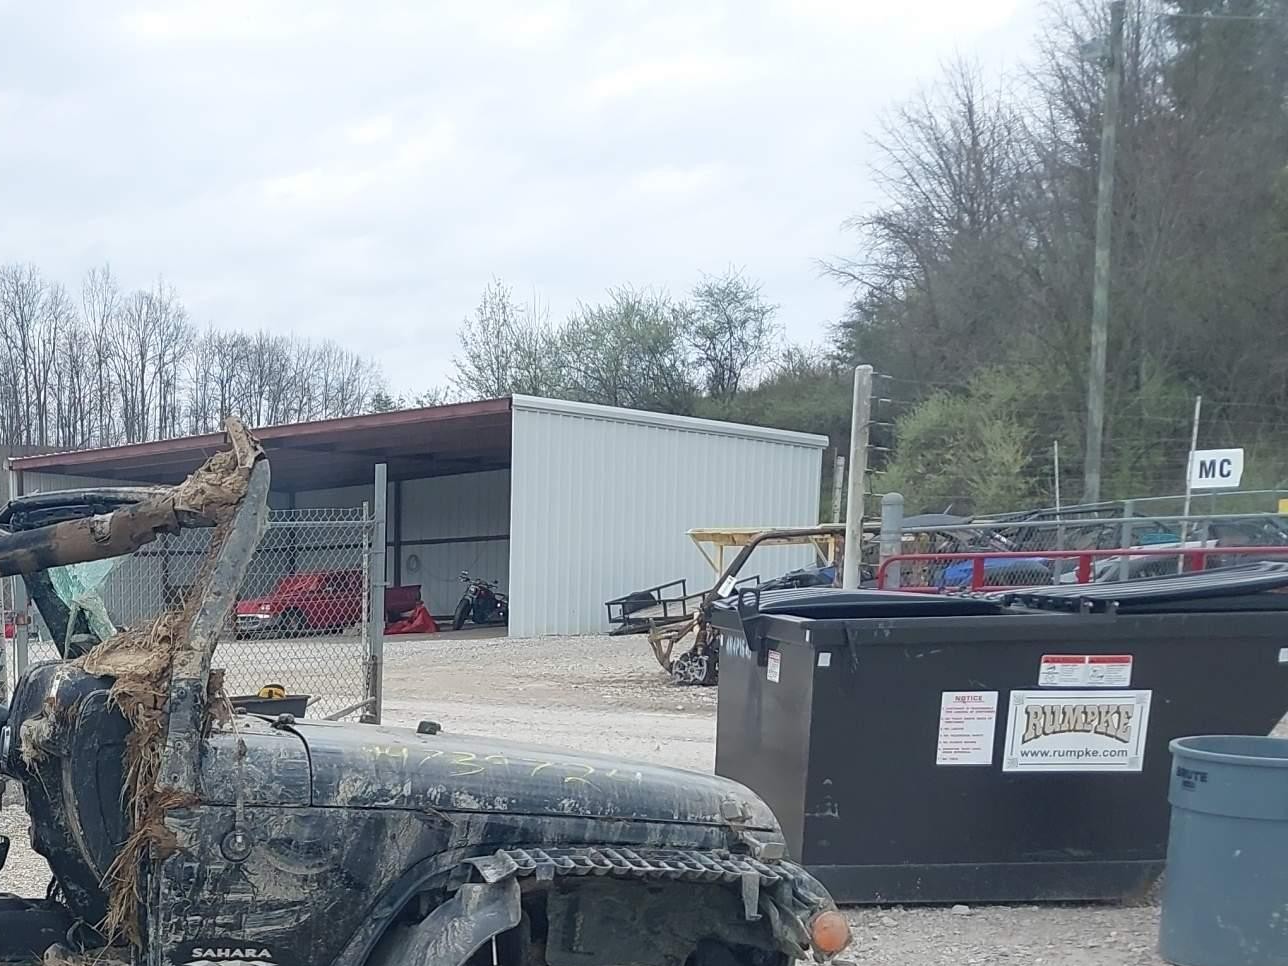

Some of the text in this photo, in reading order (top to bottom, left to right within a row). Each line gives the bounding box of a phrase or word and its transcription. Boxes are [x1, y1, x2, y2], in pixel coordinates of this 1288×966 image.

[1199, 458, 1232, 479] MC
[1022, 704, 1134, 744] RUMPKE
[1020, 748, 1128, 759] www.rumpke.com
[192, 947, 272, 958] SAHARA
